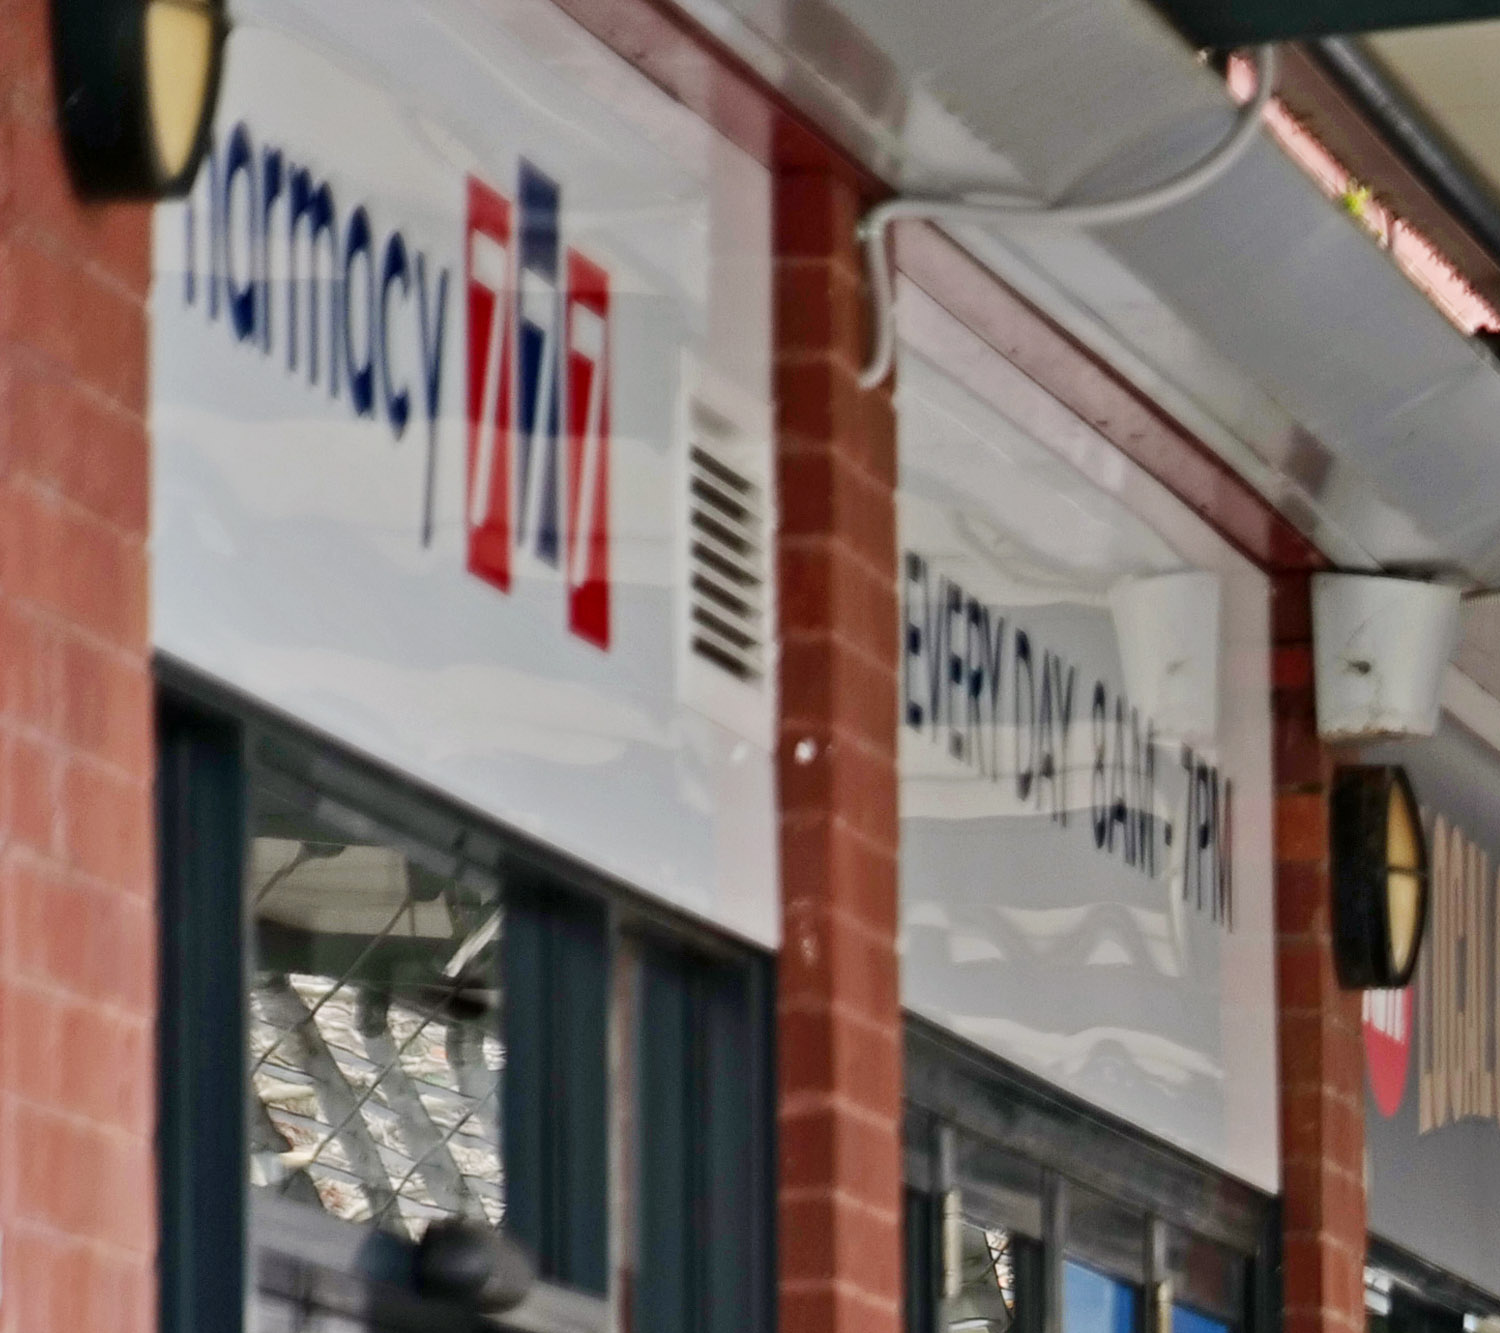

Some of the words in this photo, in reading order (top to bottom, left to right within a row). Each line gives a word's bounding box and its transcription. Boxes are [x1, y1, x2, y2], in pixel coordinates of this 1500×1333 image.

[906, 553, 1004, 782] EVERY
[1014, 628, 1075, 829] DAY
[1092, 680, 1154, 879] 8AM
[1182, 742, 1233, 934] 7PM
